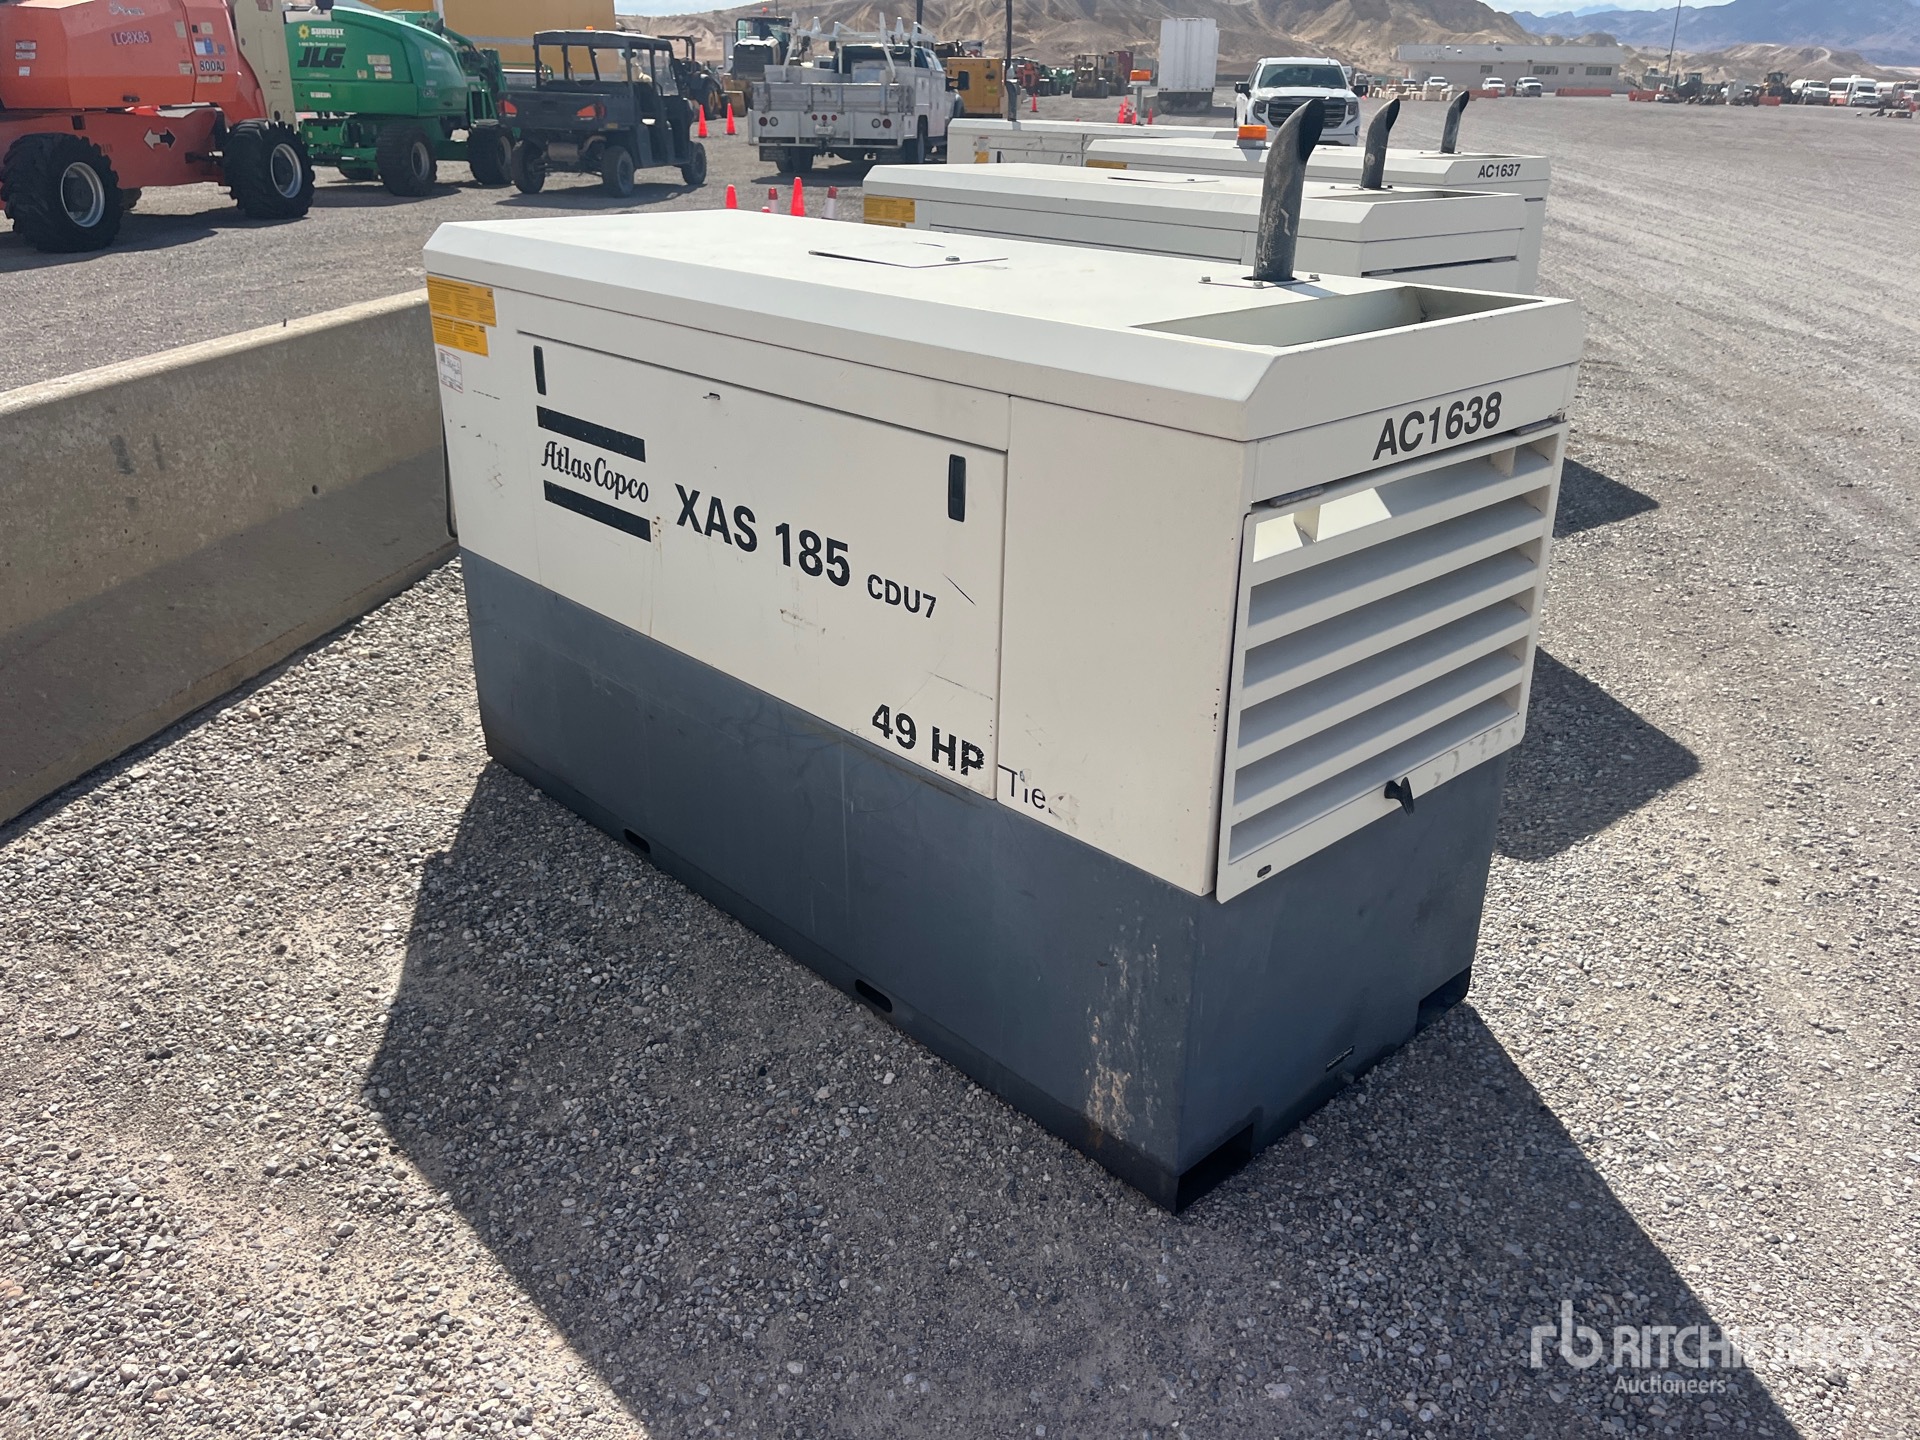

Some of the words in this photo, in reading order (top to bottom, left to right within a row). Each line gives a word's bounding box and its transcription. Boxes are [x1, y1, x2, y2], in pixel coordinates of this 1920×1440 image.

[199, 60, 226, 72] 800AJ
[297, 47, 346, 68] JLG
[1478, 163, 1521, 178] AC1637
[1372, 391, 1502, 460] AC1638
[541, 440, 592, 483] Atlas
[593, 457, 649, 503] Copco
[674, 483, 758, 553] XAS
[775, 522, 851, 587] 185
[867, 574, 937, 619] CDU7
[872, 703, 917, 750] 49
[931, 726, 985, 776] HP
